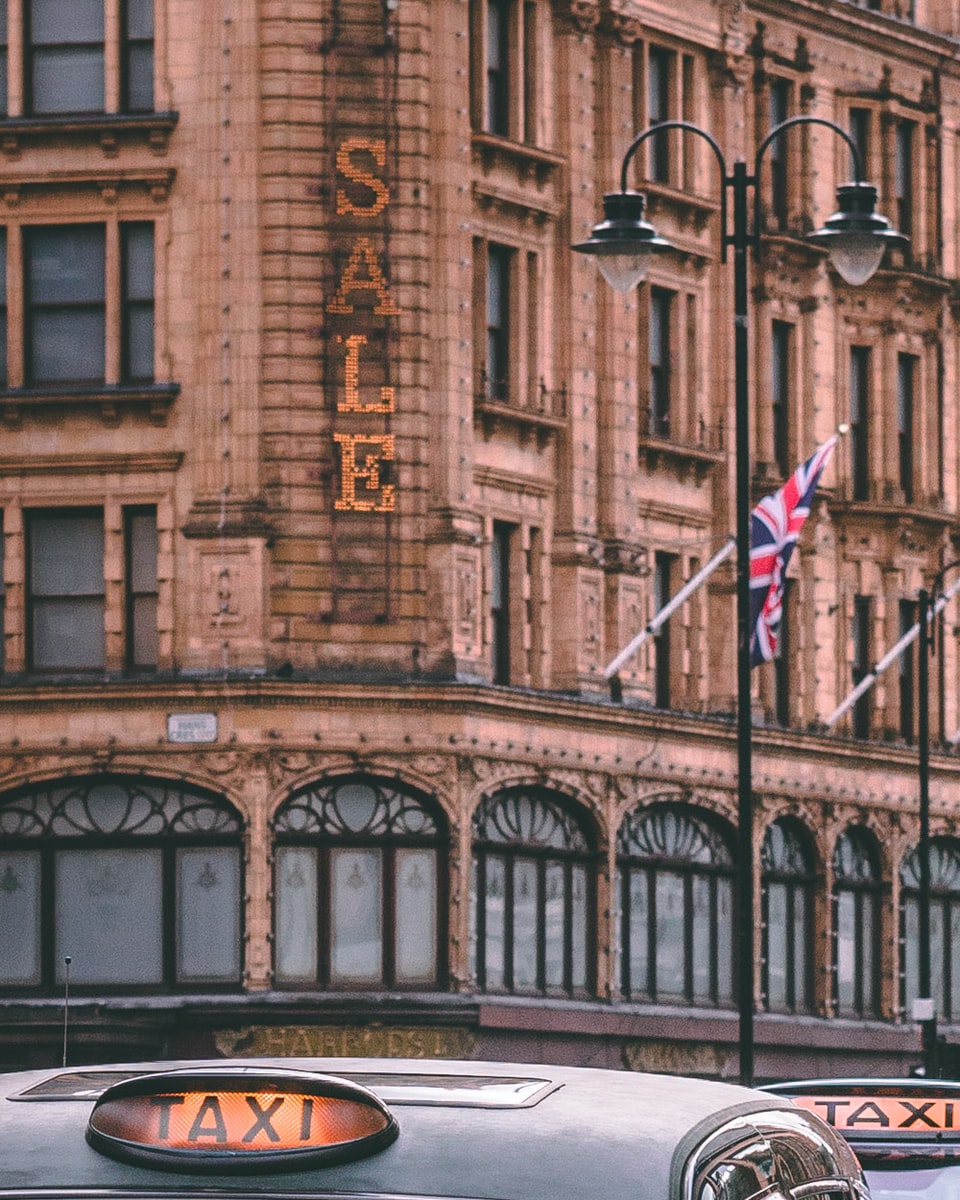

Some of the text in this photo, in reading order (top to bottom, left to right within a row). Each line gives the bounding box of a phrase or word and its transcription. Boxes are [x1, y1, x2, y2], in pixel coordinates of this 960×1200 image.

[326, 138, 399, 512] SALE
[151, 1096, 314, 1142] TAXI
[815, 1101, 953, 1128] TAXI
